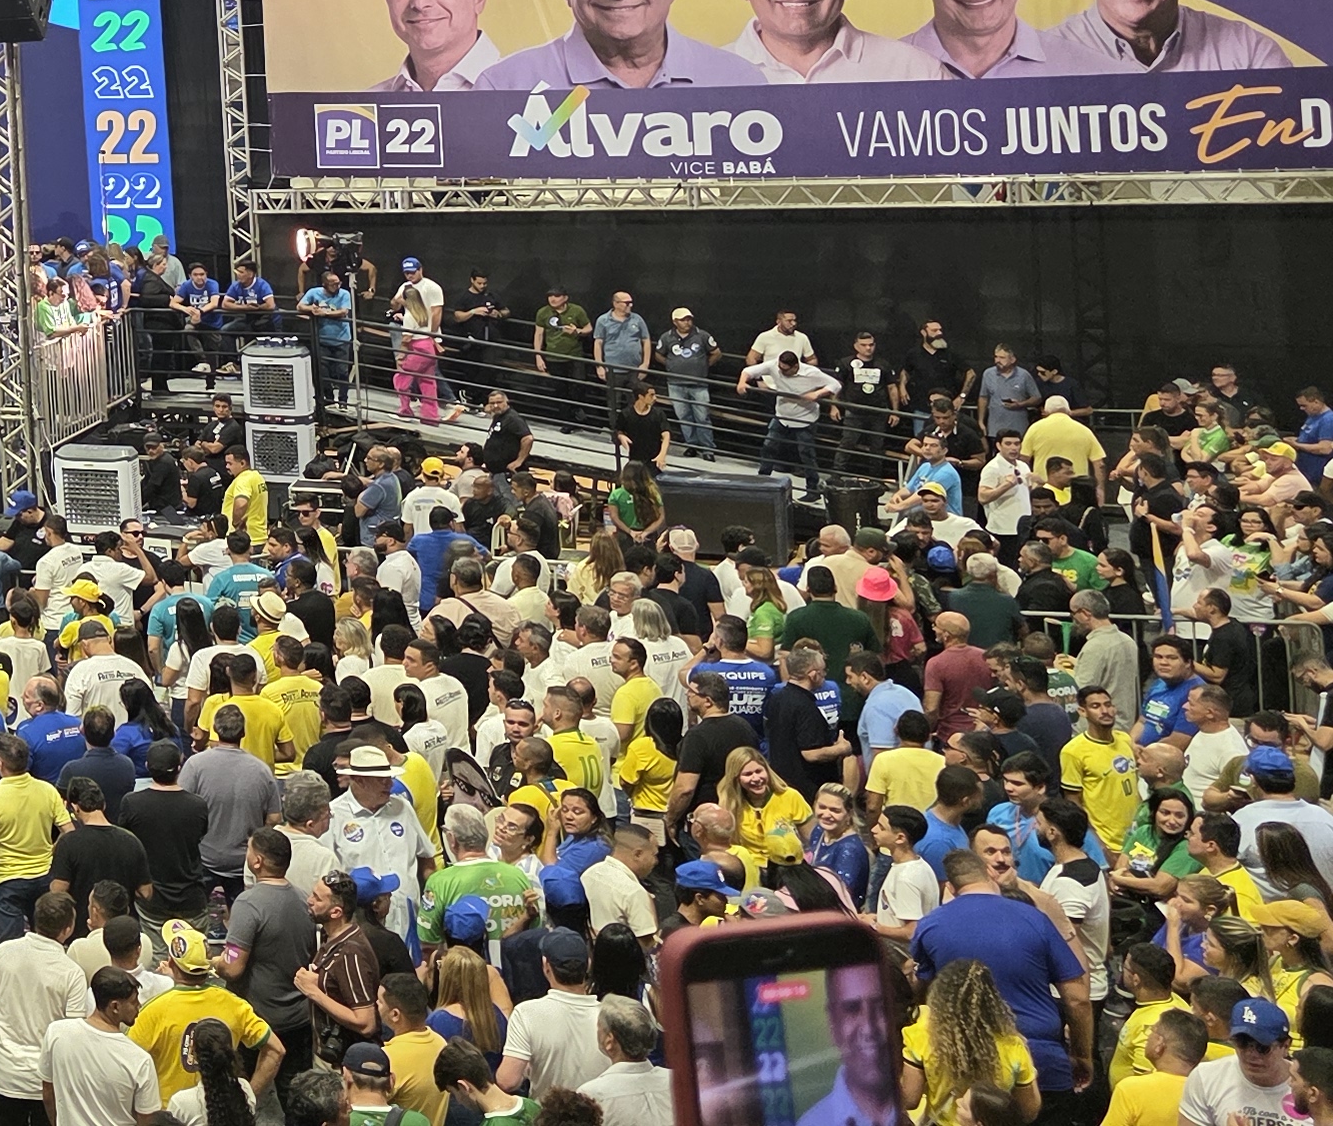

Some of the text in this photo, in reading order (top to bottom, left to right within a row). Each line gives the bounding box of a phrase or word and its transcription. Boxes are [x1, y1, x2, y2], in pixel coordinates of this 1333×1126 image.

[90, 9, 151, 53] 22
[92, 64, 155, 99] 22
[326, 118, 370, 148] PL
[385, 118, 436, 153] 22
[507, 79, 784, 158] Álvaro
[836, 107, 988, 158] VAMOS
[1000, 102, 1168, 155] JUNTOS
[96, 109, 160, 164] 22
[670, 157, 777, 175] VICE BABÁ
[101, 171, 163, 210] 22
[578, 754, 604, 786] 10
[1121, 778, 1133, 797] 10
[1242, 1006, 1257, 1024] LA
